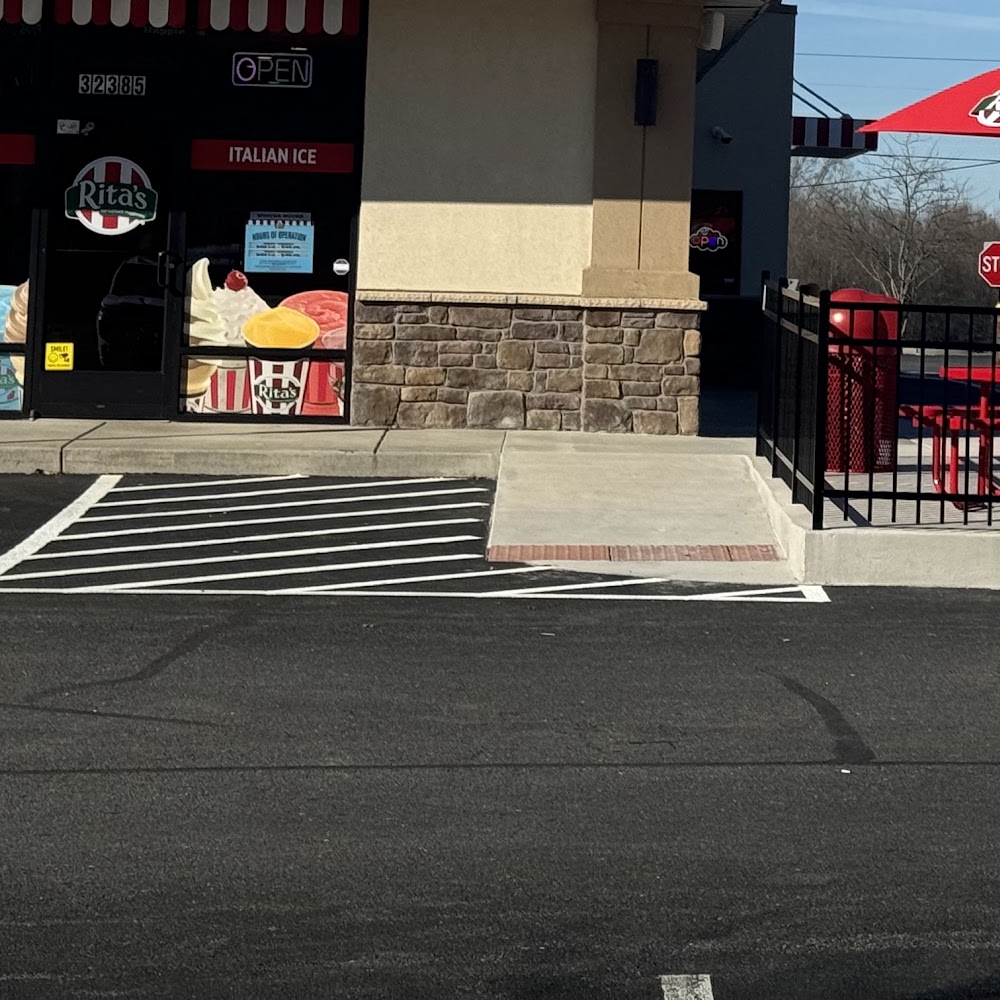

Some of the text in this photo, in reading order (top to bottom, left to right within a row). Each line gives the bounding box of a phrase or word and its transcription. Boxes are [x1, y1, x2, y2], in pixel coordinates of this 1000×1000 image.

[236, 57, 310, 83] OPEN
[80, 74, 145, 95] 32385
[229, 146, 317, 165] ITALIAN ICE
[79, 180, 148, 210] Rita's
[259, 384, 297, 400] Rita's
